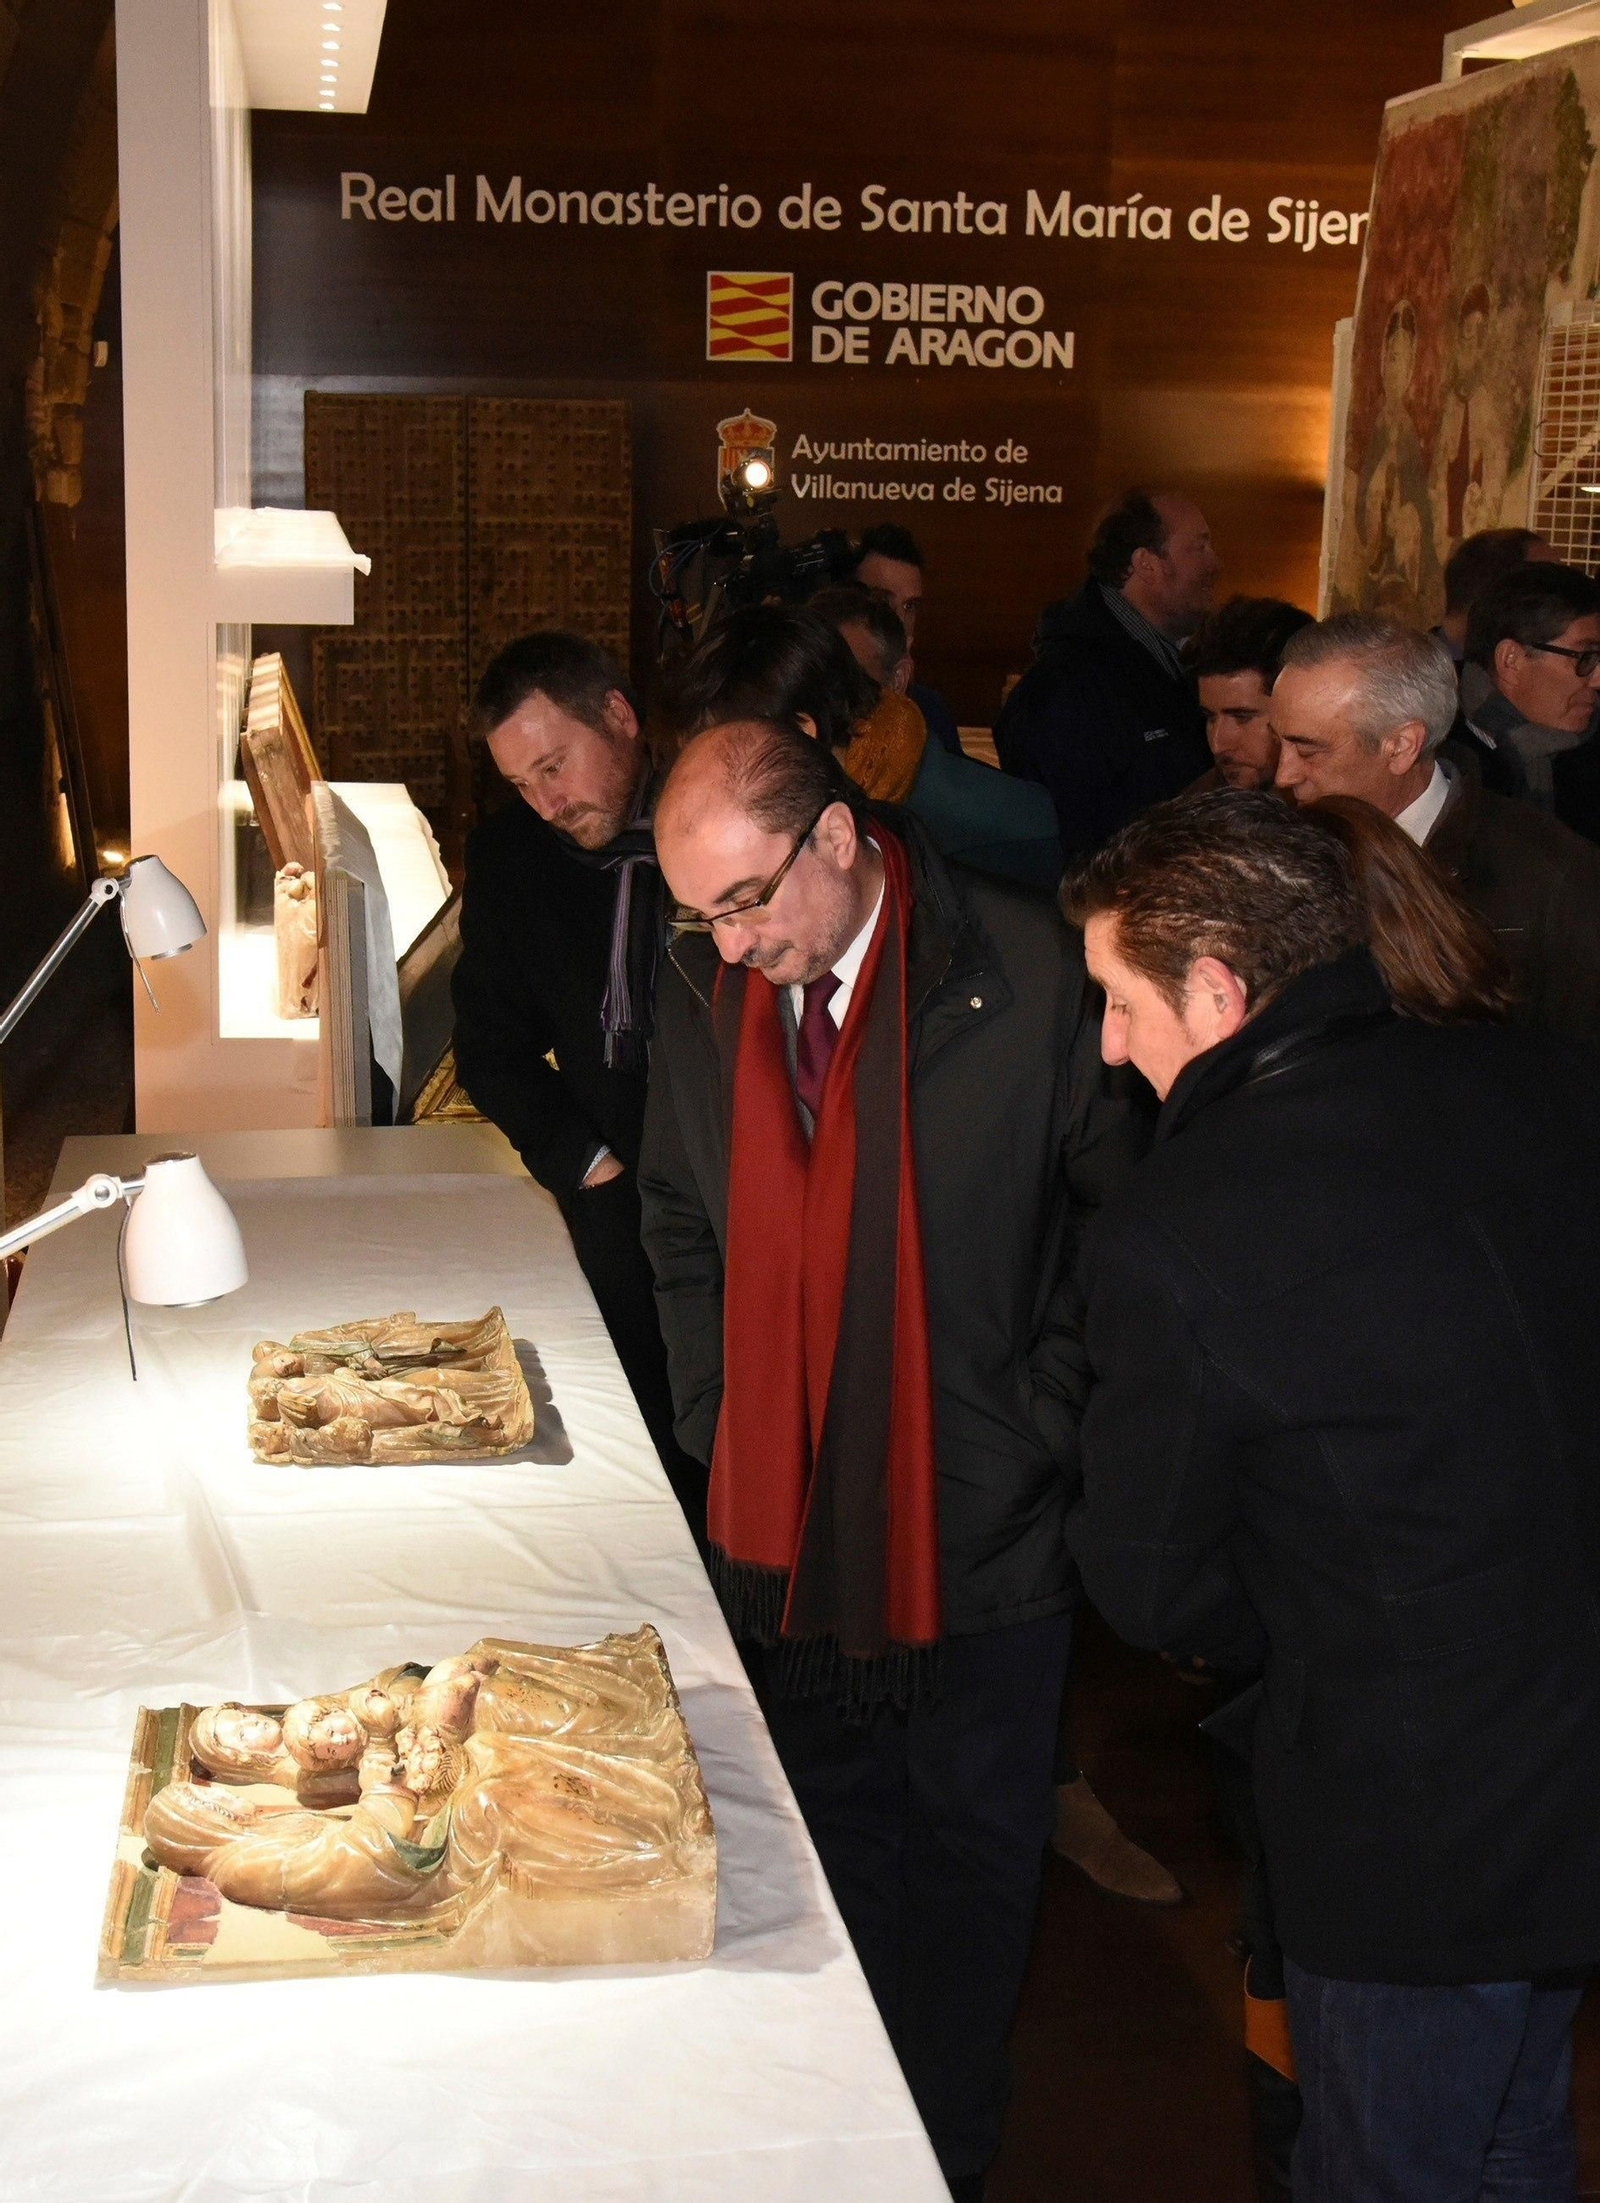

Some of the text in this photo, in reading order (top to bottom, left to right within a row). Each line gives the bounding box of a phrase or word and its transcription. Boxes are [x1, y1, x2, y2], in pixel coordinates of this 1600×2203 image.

[340, 172, 456, 222] Real
[476, 174, 762, 228] Monasterio
[778, 182, 842, 231] de
[860, 184, 1008, 235] Santa
[1025, 189, 1172, 240] María
[1187, 194, 1251, 242] de
[811, 280, 1045, 325] GOBIERNO
[811, 325, 1075, 369] DE ARAGON
[791, 433, 1029, 465] Ayuntamiento de
[790, 473, 1063, 507] Villanueva de Sijena
